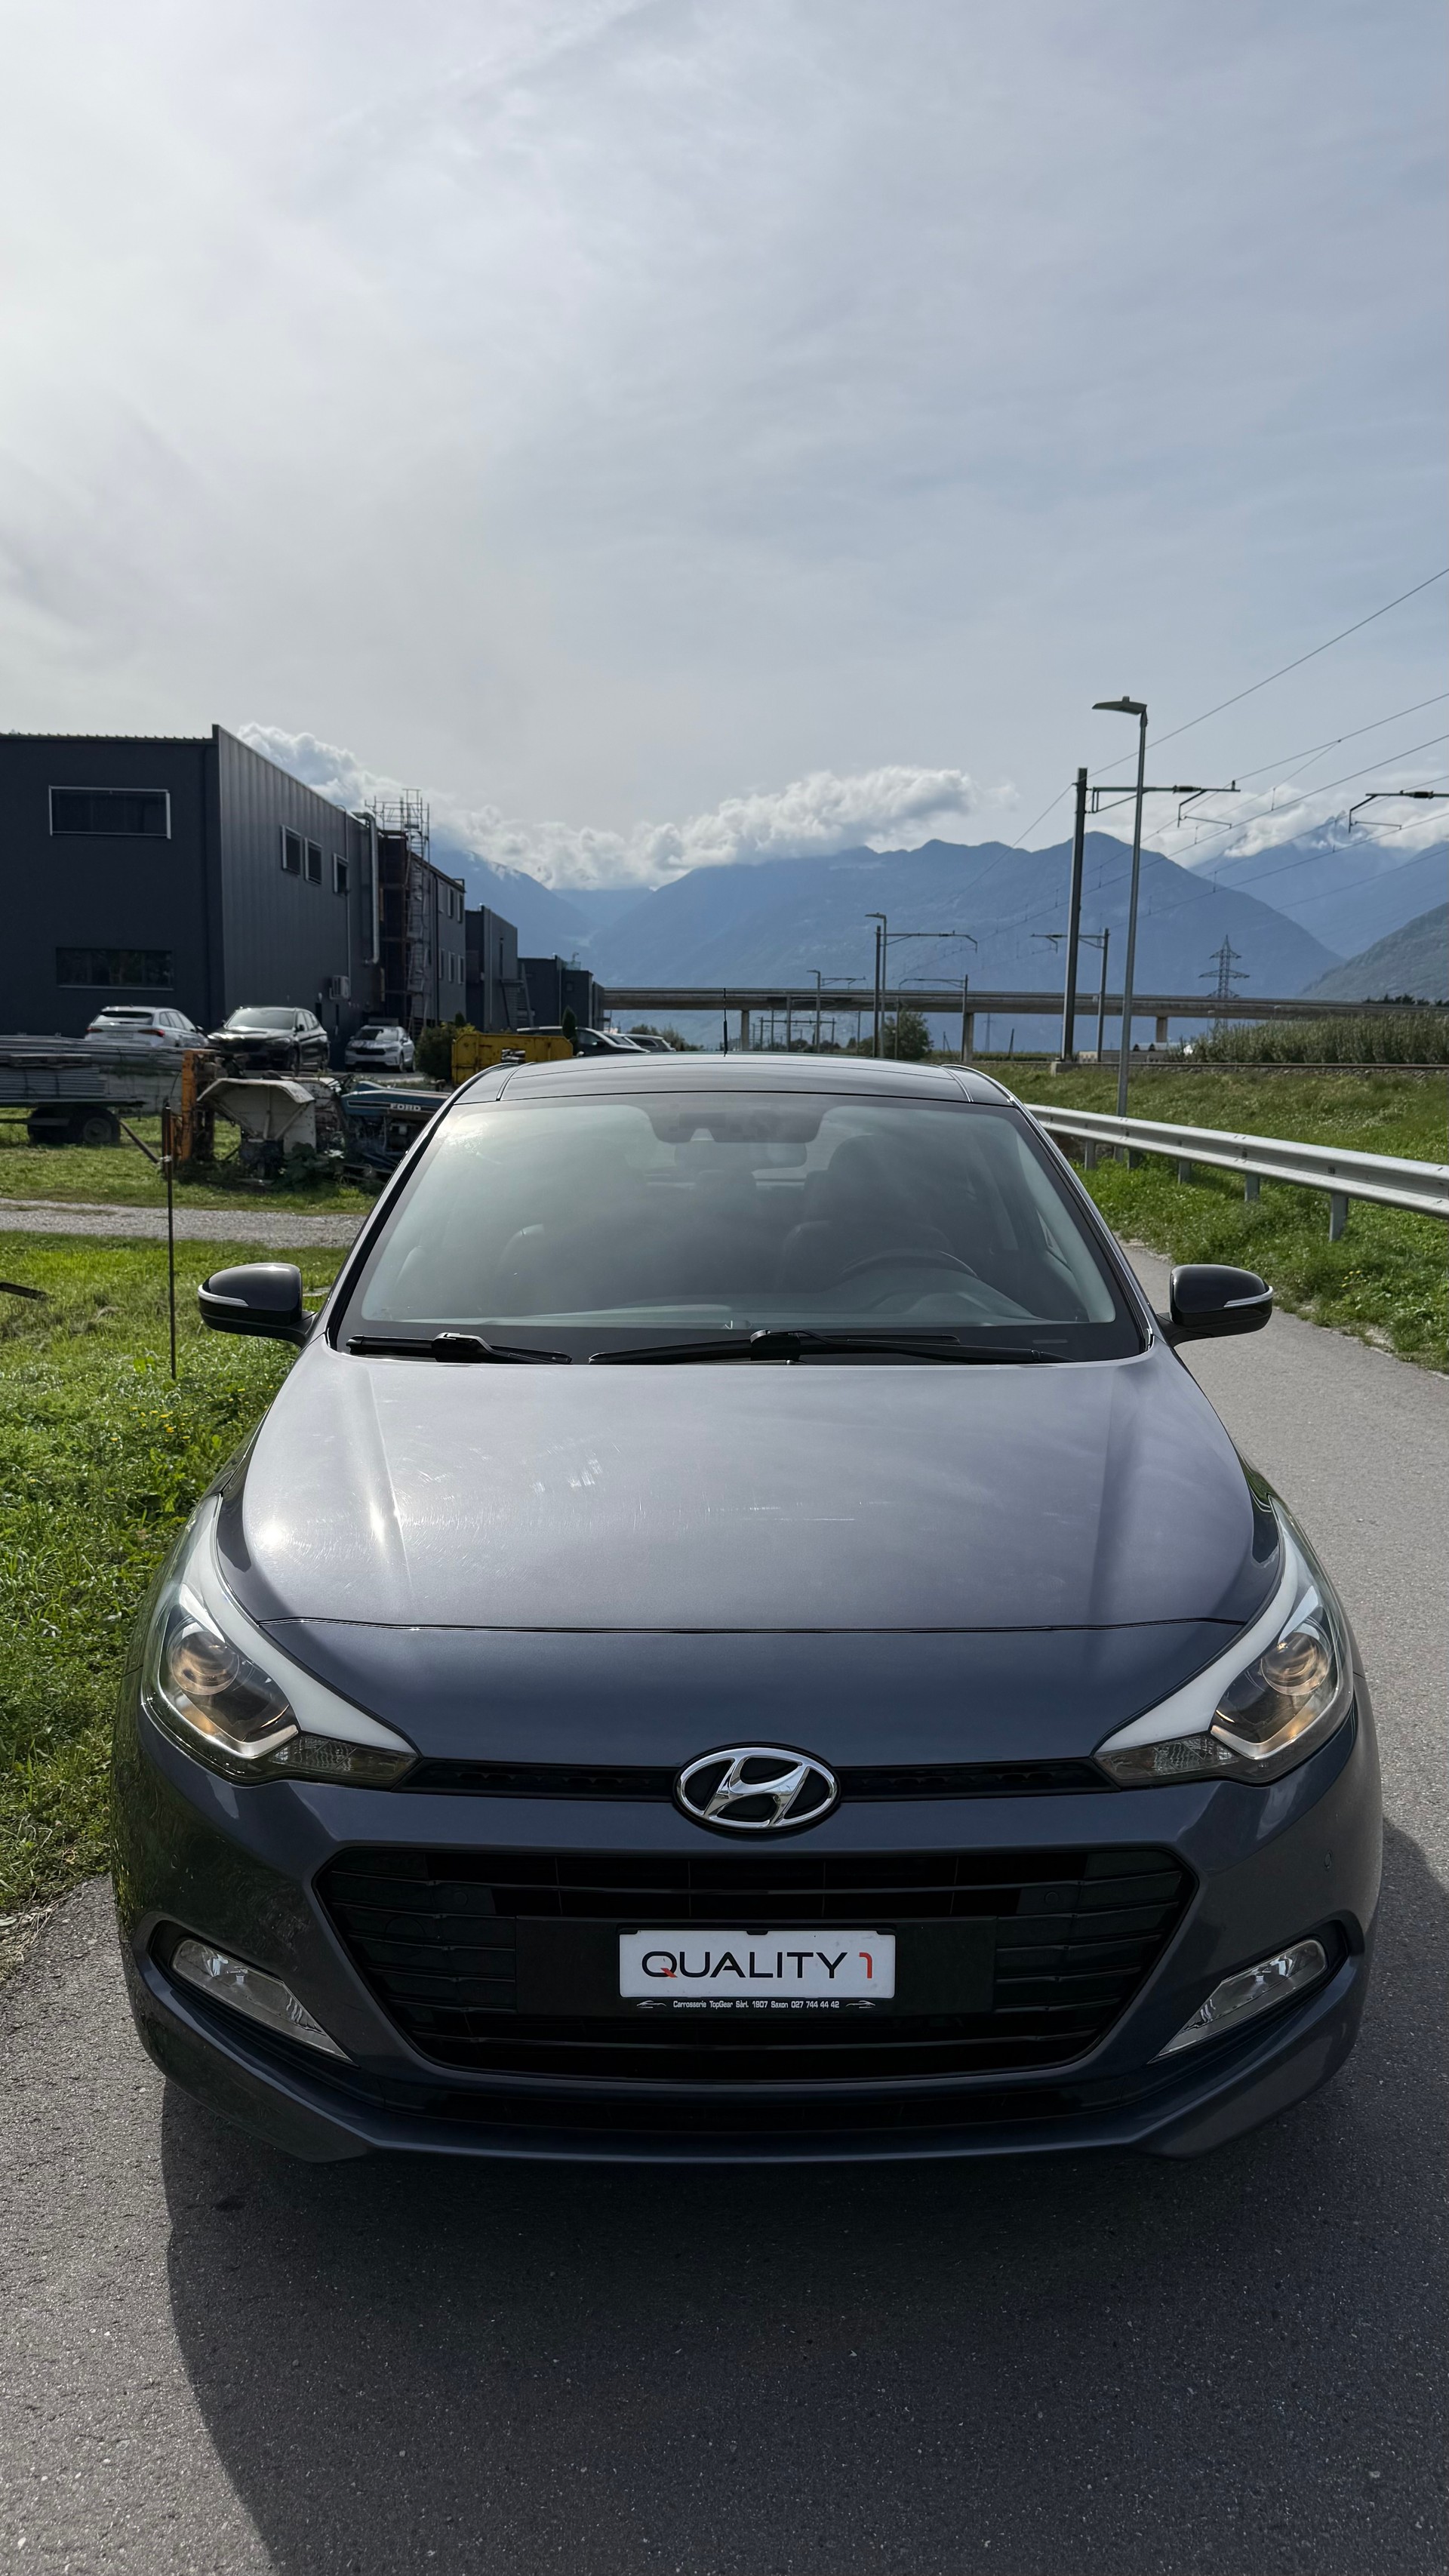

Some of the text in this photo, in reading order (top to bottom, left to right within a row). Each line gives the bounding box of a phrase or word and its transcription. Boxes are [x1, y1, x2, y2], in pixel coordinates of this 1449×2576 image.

[390, 1103, 421, 1112] FORD
[641, 1951, 873, 1979] QUALITY 1
[673, 2000, 707, 2008] Carrosserie
[709, 2000, 734, 2010] TopGear
[752, 2000, 768, 2008] 1907
[771, 2000, 789, 2008] Saxon
[791, 2000, 804, 2008] 027
[805, 2000, 819, 2008] 744
[820, 2000, 829, 2008] 44
[830, 2000, 840, 2008] 42
